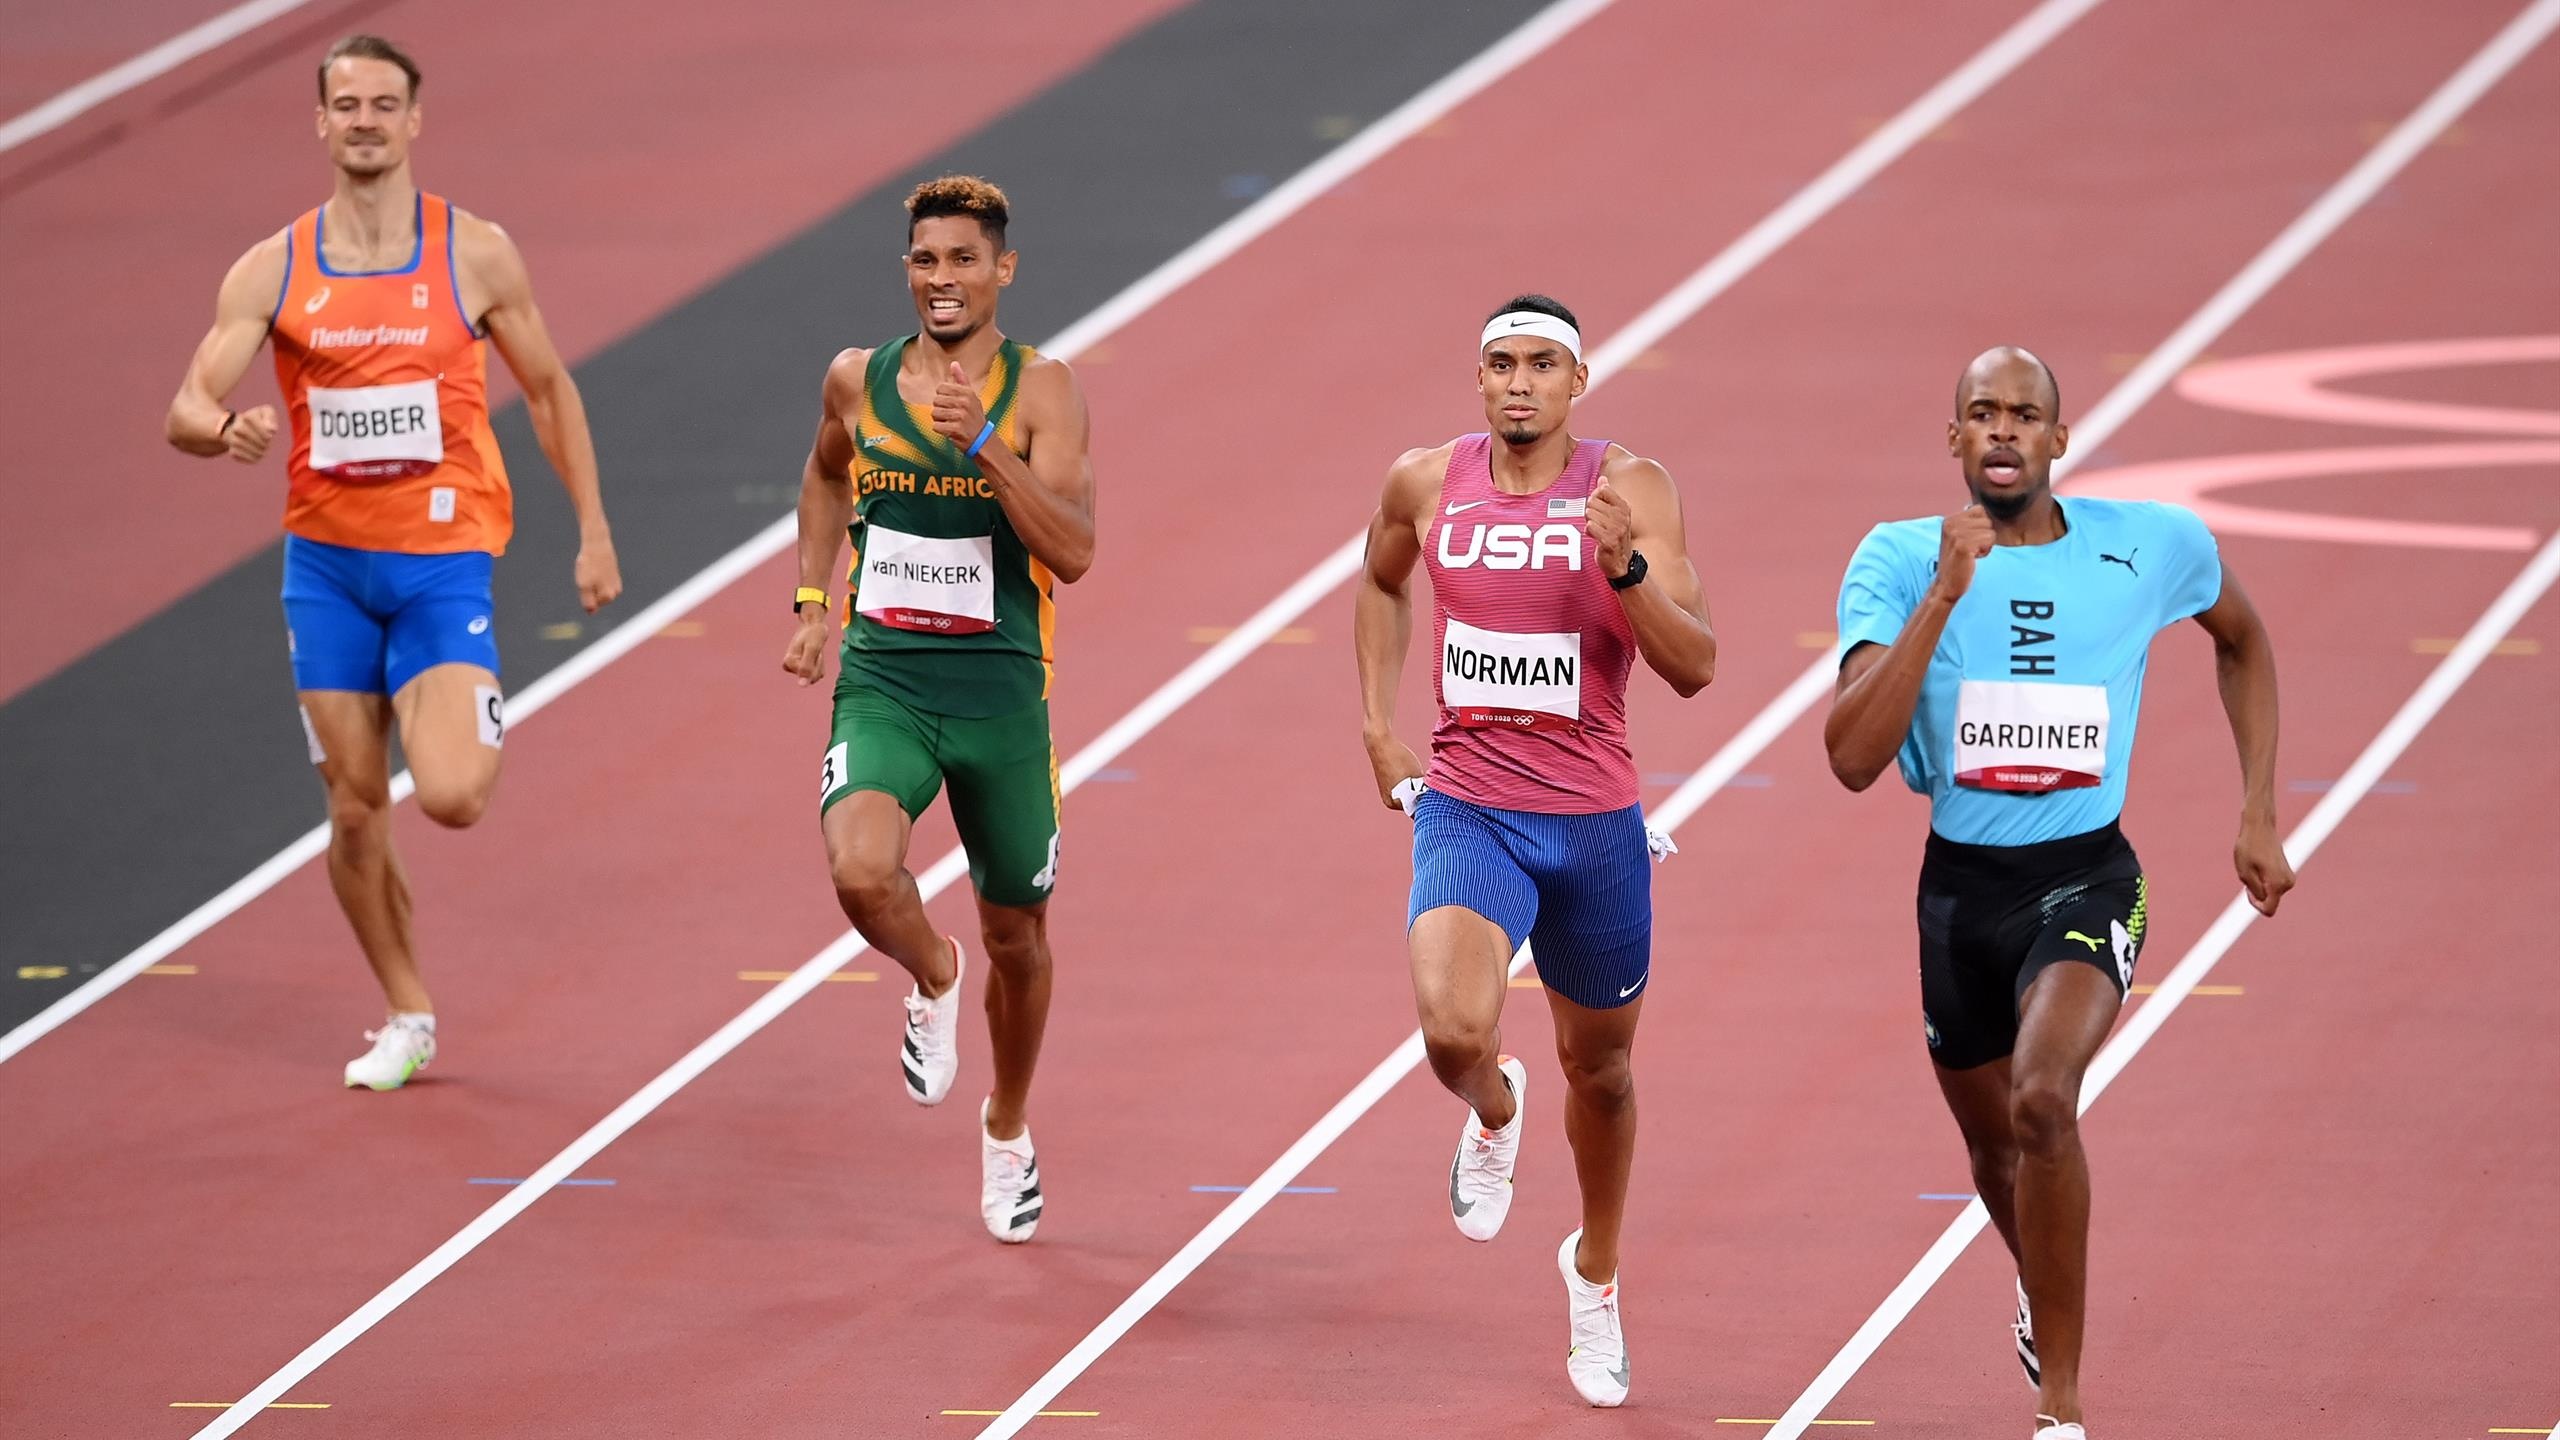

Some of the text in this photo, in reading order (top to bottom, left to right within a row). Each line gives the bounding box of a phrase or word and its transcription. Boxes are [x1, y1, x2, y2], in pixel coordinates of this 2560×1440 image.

[320, 405, 426, 438] DOBBER
[923, 475, 996, 498] AFRIC
[1437, 523, 1582, 571] USA
[872, 559, 982, 584] van NIEKERK
[2010, 600, 2056, 676] BAH
[1447, 643, 1575, 686] NORMAN
[1471, 713, 1511, 722] TOKYO 2020
[1960, 722, 2100, 749] GARDINER
